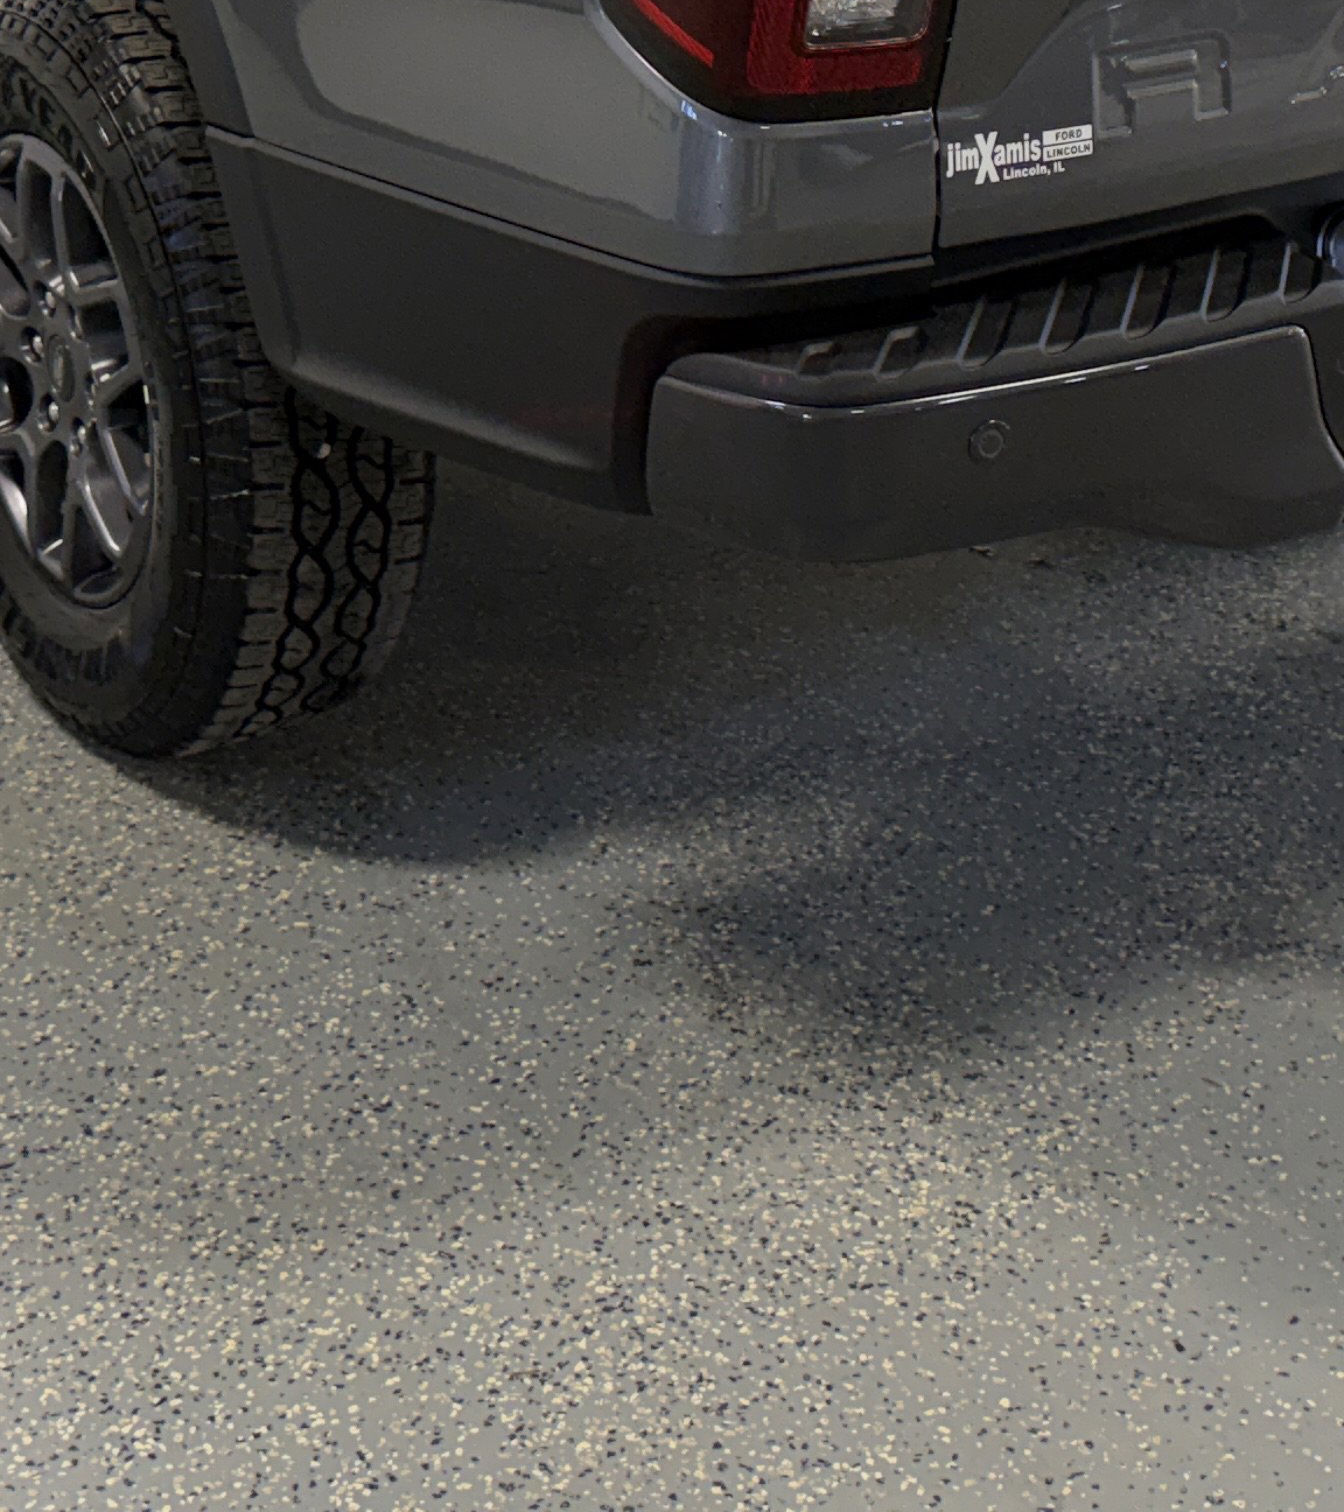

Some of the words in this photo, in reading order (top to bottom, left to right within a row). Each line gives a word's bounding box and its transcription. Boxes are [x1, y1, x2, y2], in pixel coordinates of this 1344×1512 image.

[1055, 129, 1083, 141] FORD
[946, 131, 1042, 185] jimXamis
[1046, 143, 1091, 159] LINCOLN
[1003, 163, 1051, 180] Lincoln,
[1054, 161, 1065, 173] IL
